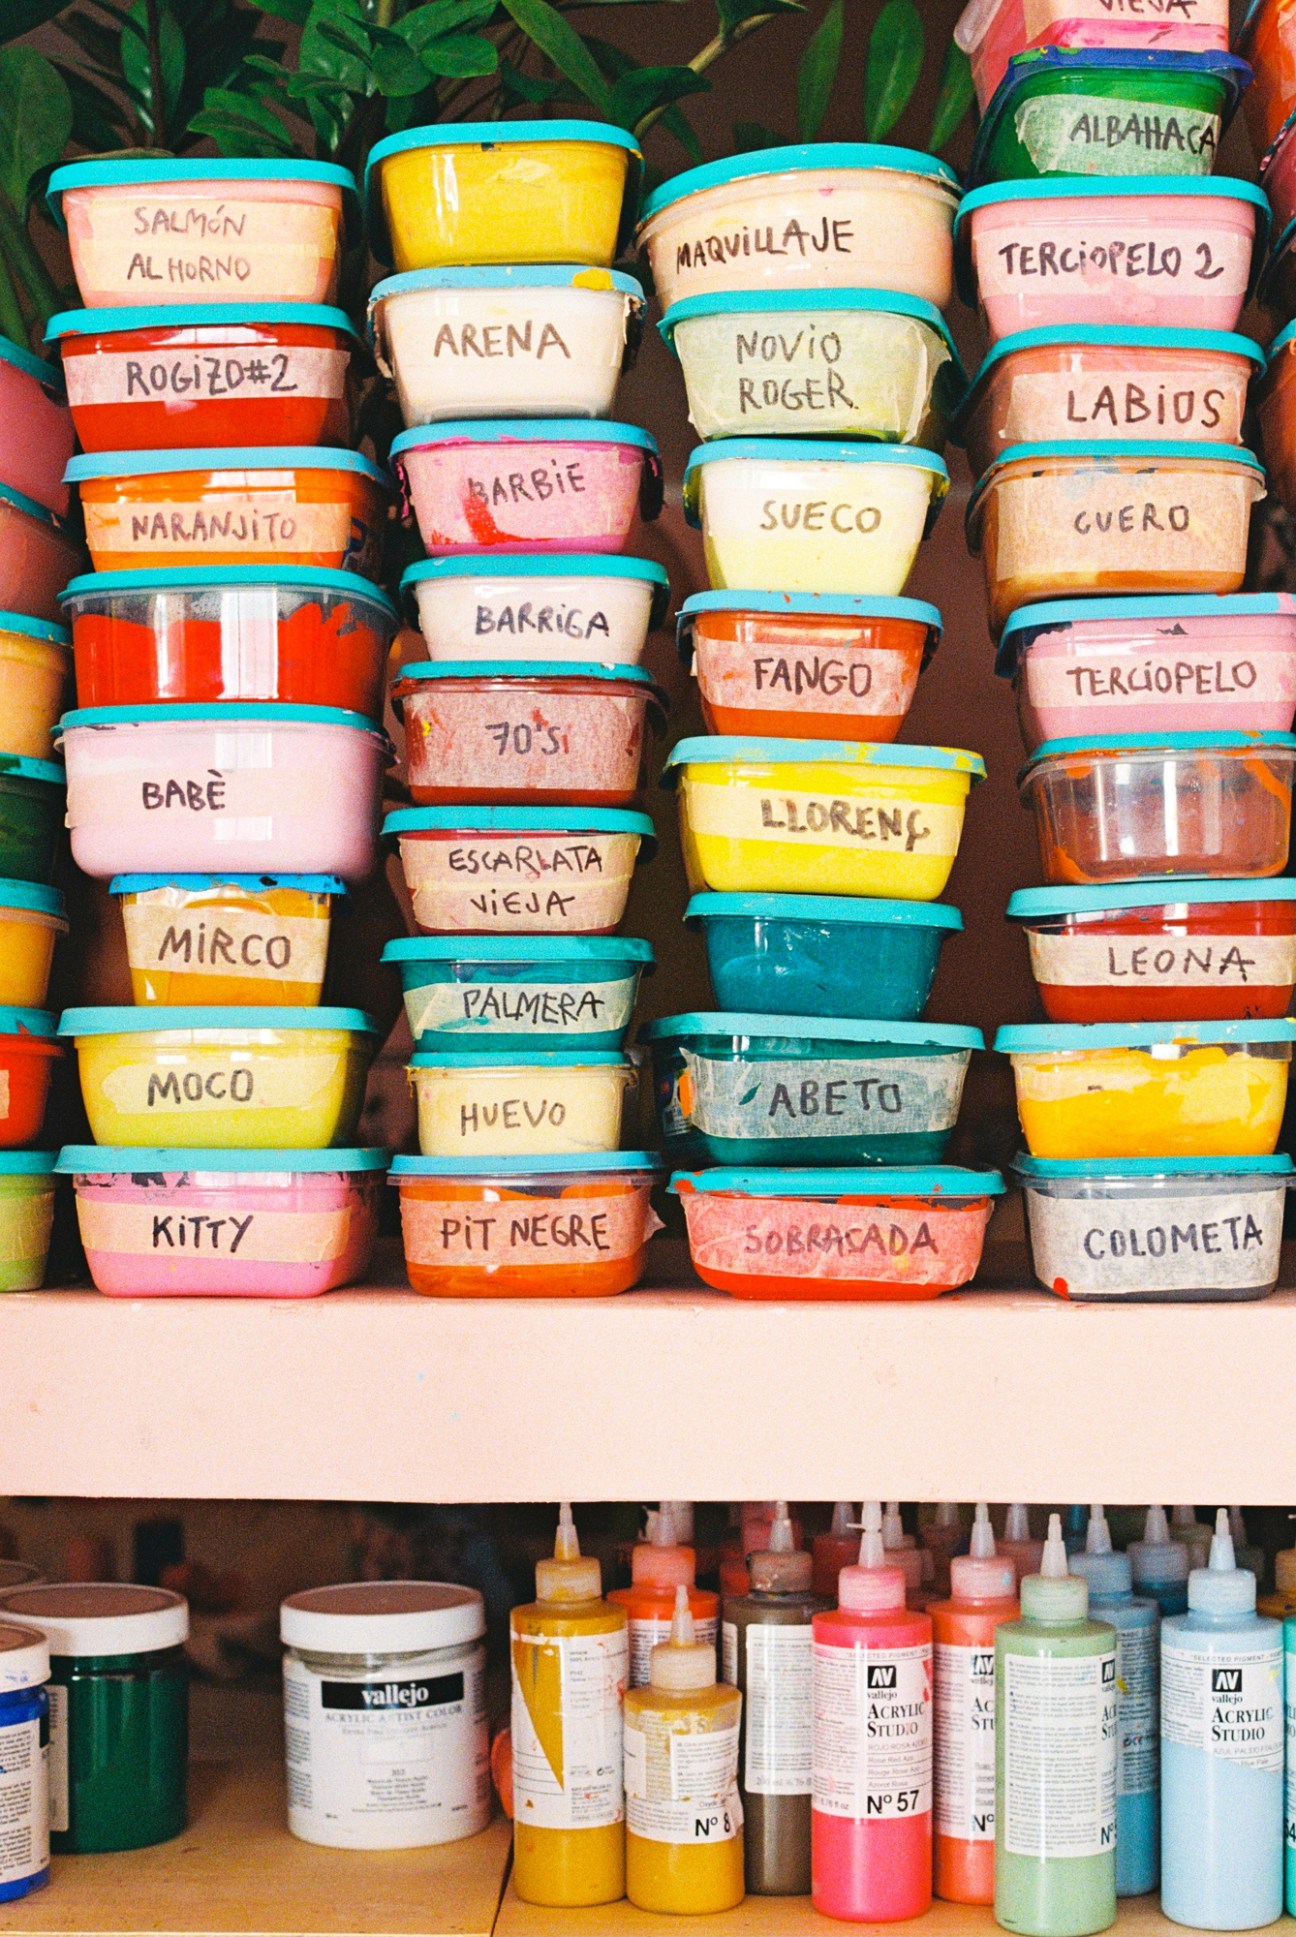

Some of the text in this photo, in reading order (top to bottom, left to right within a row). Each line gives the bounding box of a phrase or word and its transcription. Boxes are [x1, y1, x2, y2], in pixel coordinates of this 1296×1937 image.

[1070, 113, 1216, 155] ALBAHACA
[134, 204, 246, 237] SALMÓN
[127, 252, 251, 283] AL HORNO
[1195, 243, 1224, 279] 2
[433, 323, 571, 359] ARENA
[760, 501, 881, 534] SUECO
[1074, 505, 1190, 533] CUERO
[755, 658, 872, 697] FANGO
[142, 769, 226, 811] BABÈ
[449, 845, 602, 875] ESCARLATA
[1108, 946, 1255, 981] LEONA
[463, 989, 604, 1024] PALMERA
[149, 1069, 254, 1107] MOCO
[769, 1078, 902, 1118] ABETO
[461, 1101, 566, 1136] HUEVO
[511, 1214, 611, 1251] NEGRE
[1085, 1216, 1264, 1260] COLOMETA
[361, 1682, 429, 1707] vallejo
[867, 1691, 897, 1700] vallejo
[868, 1702, 925, 1720] ACRYLIC
[1212, 1695, 1242, 1704] vallejo
[867, 1722, 918, 1737] STUDIO
[1212, 1707, 1274, 1723] ACRYLIC
[1212, 1725, 1265, 1742] STUDIO
[897, 1790, 919, 1812] 57
[724, 1813, 731, 1833] 8
